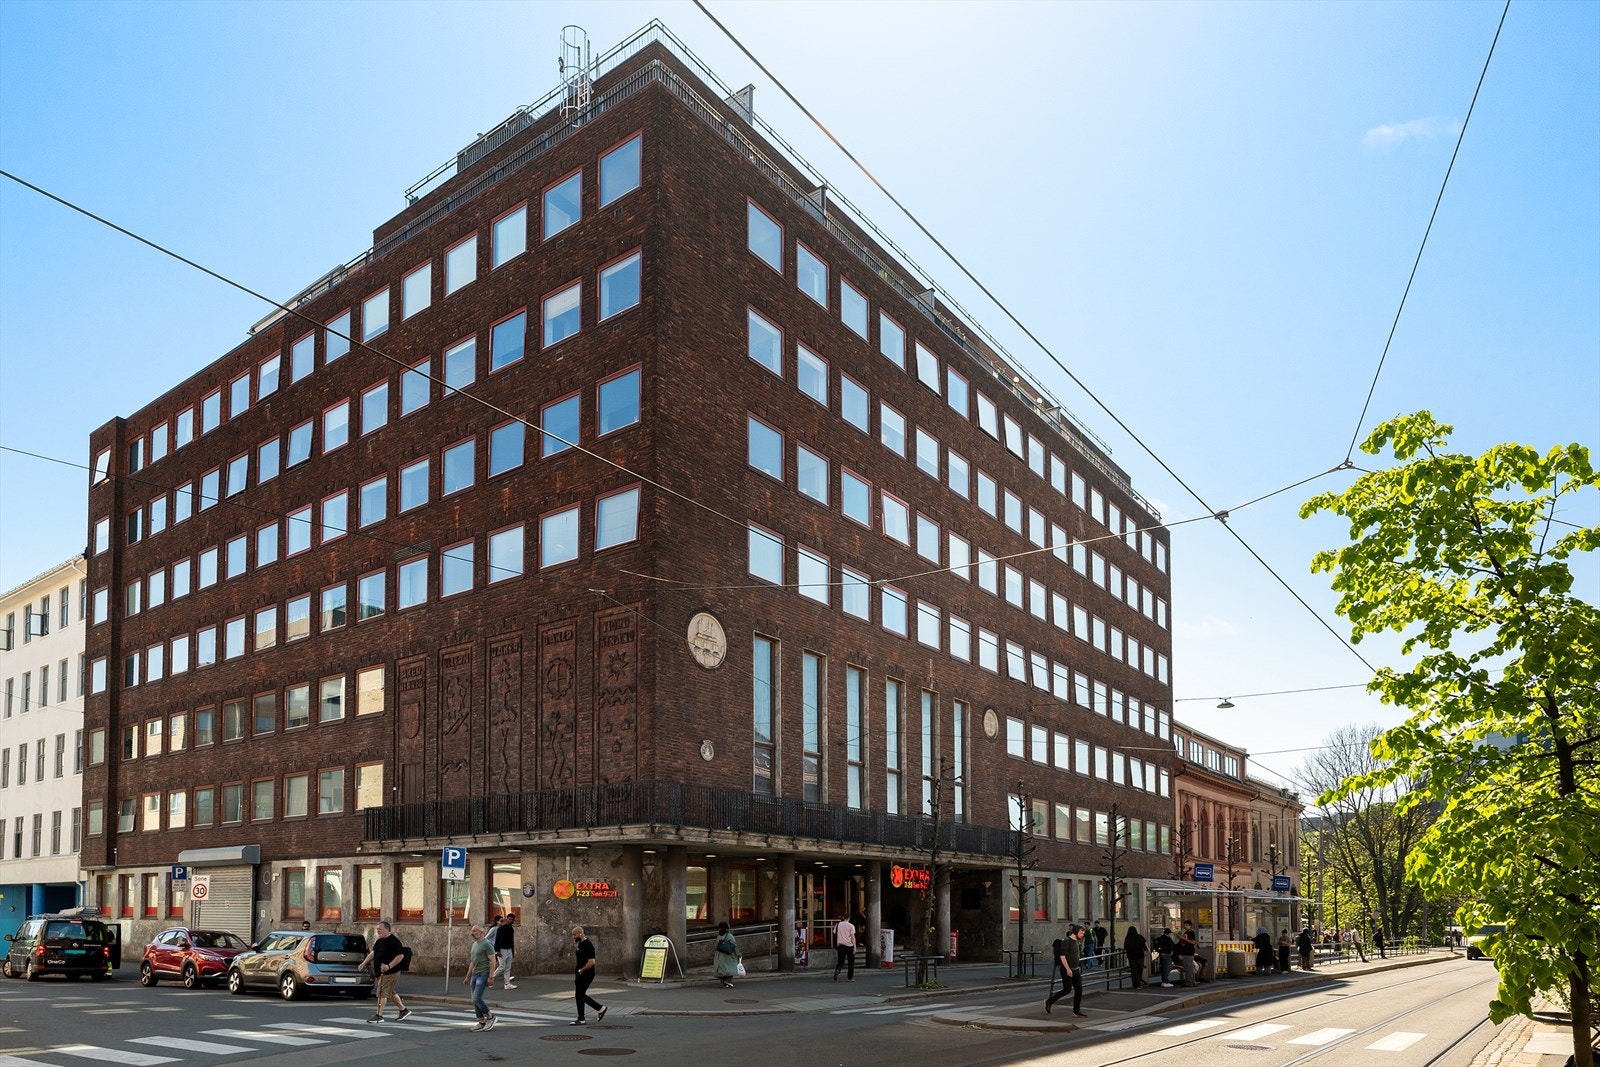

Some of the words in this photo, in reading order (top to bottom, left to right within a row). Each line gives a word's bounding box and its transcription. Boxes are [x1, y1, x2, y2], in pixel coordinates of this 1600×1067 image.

[448, 849, 461, 865] P
[175, 867, 184, 878] P
[904, 868, 930, 882] EXTRA
[195, 887, 205, 895] 30
[575, 882, 610, 890] EXTRA
